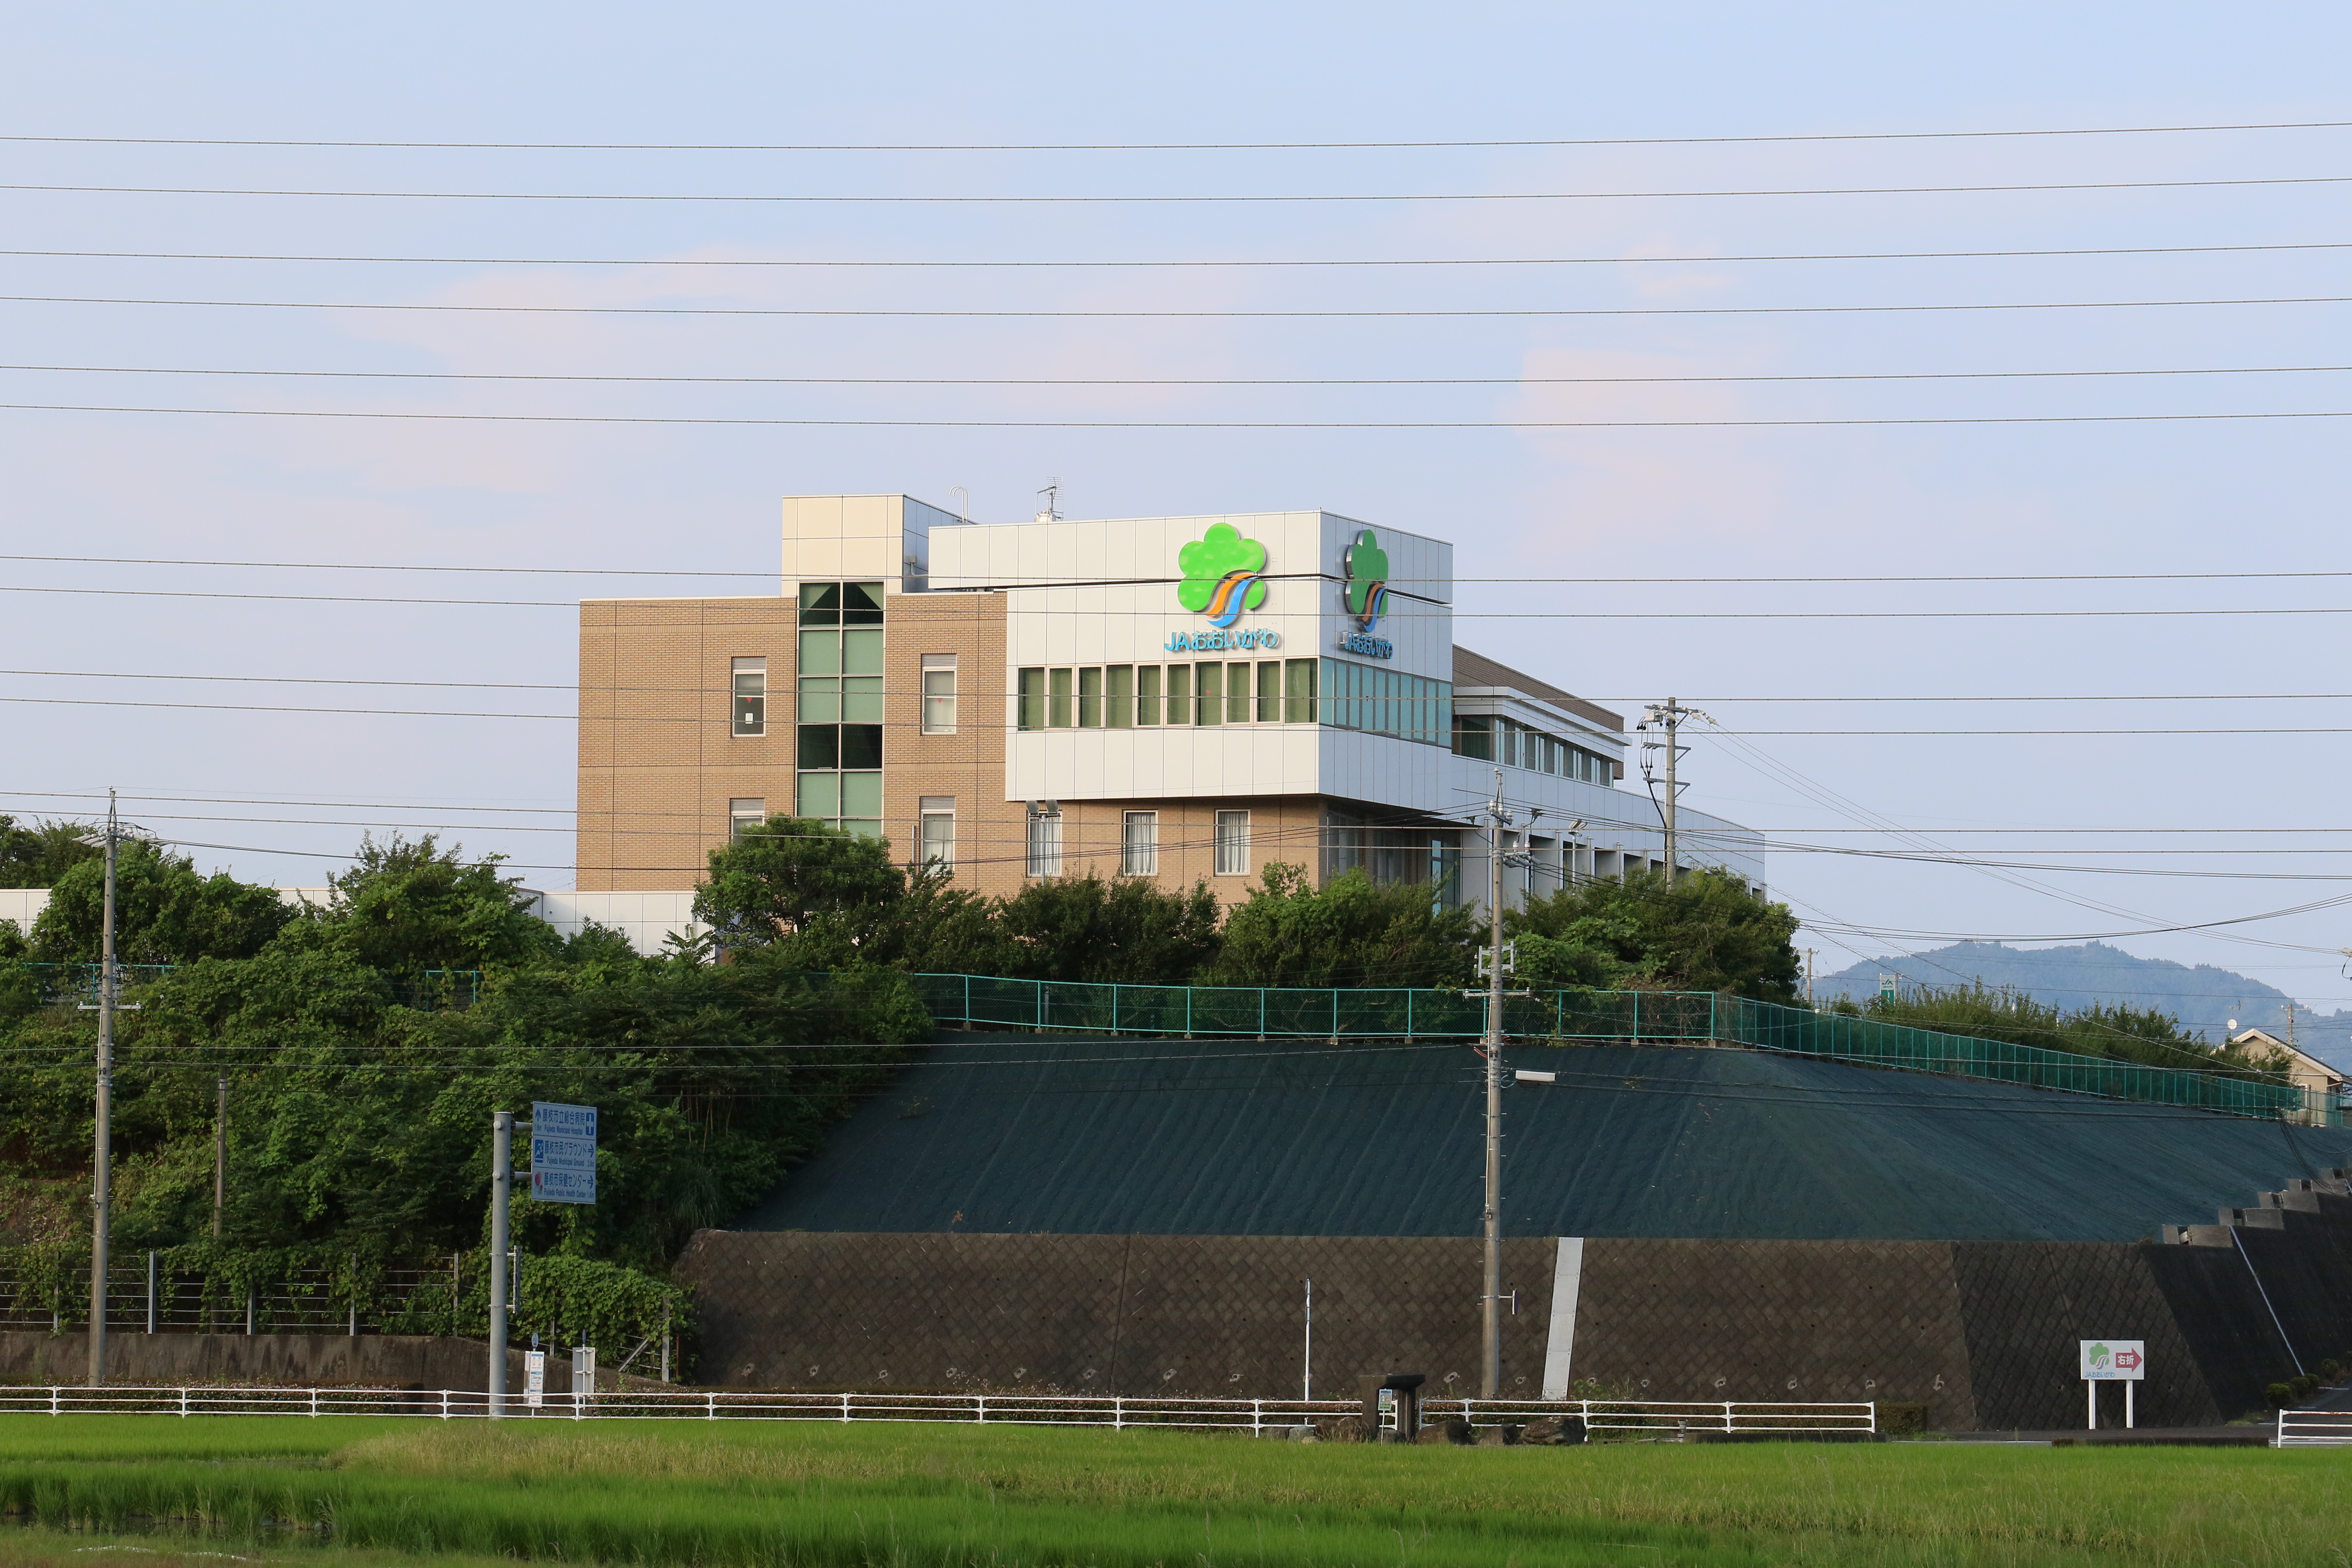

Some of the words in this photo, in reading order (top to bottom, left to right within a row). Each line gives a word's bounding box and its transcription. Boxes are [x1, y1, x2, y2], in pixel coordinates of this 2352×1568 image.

[1164, 628, 1278, 651] JAおおいがわ
[542, 1109, 585, 1125] 藤枝市立総合病院
[545, 1124, 556, 1133] Fujieda
[557, 1125, 570, 1134] Municipal
[571, 1127, 583, 1135] Hospital
[545, 1140, 587, 1157] 藤枝市民グラウンド
[547, 1156, 558, 1165] Fujieda
[559, 1157, 573, 1167] Municipal
[574, 1158, 584, 1167] Ground
[544, 1172, 586, 1188] 藤枝市保健センター
[544, 1188, 555, 1197] Fujieda
[2118, 1355, 2134, 1365] 右折
